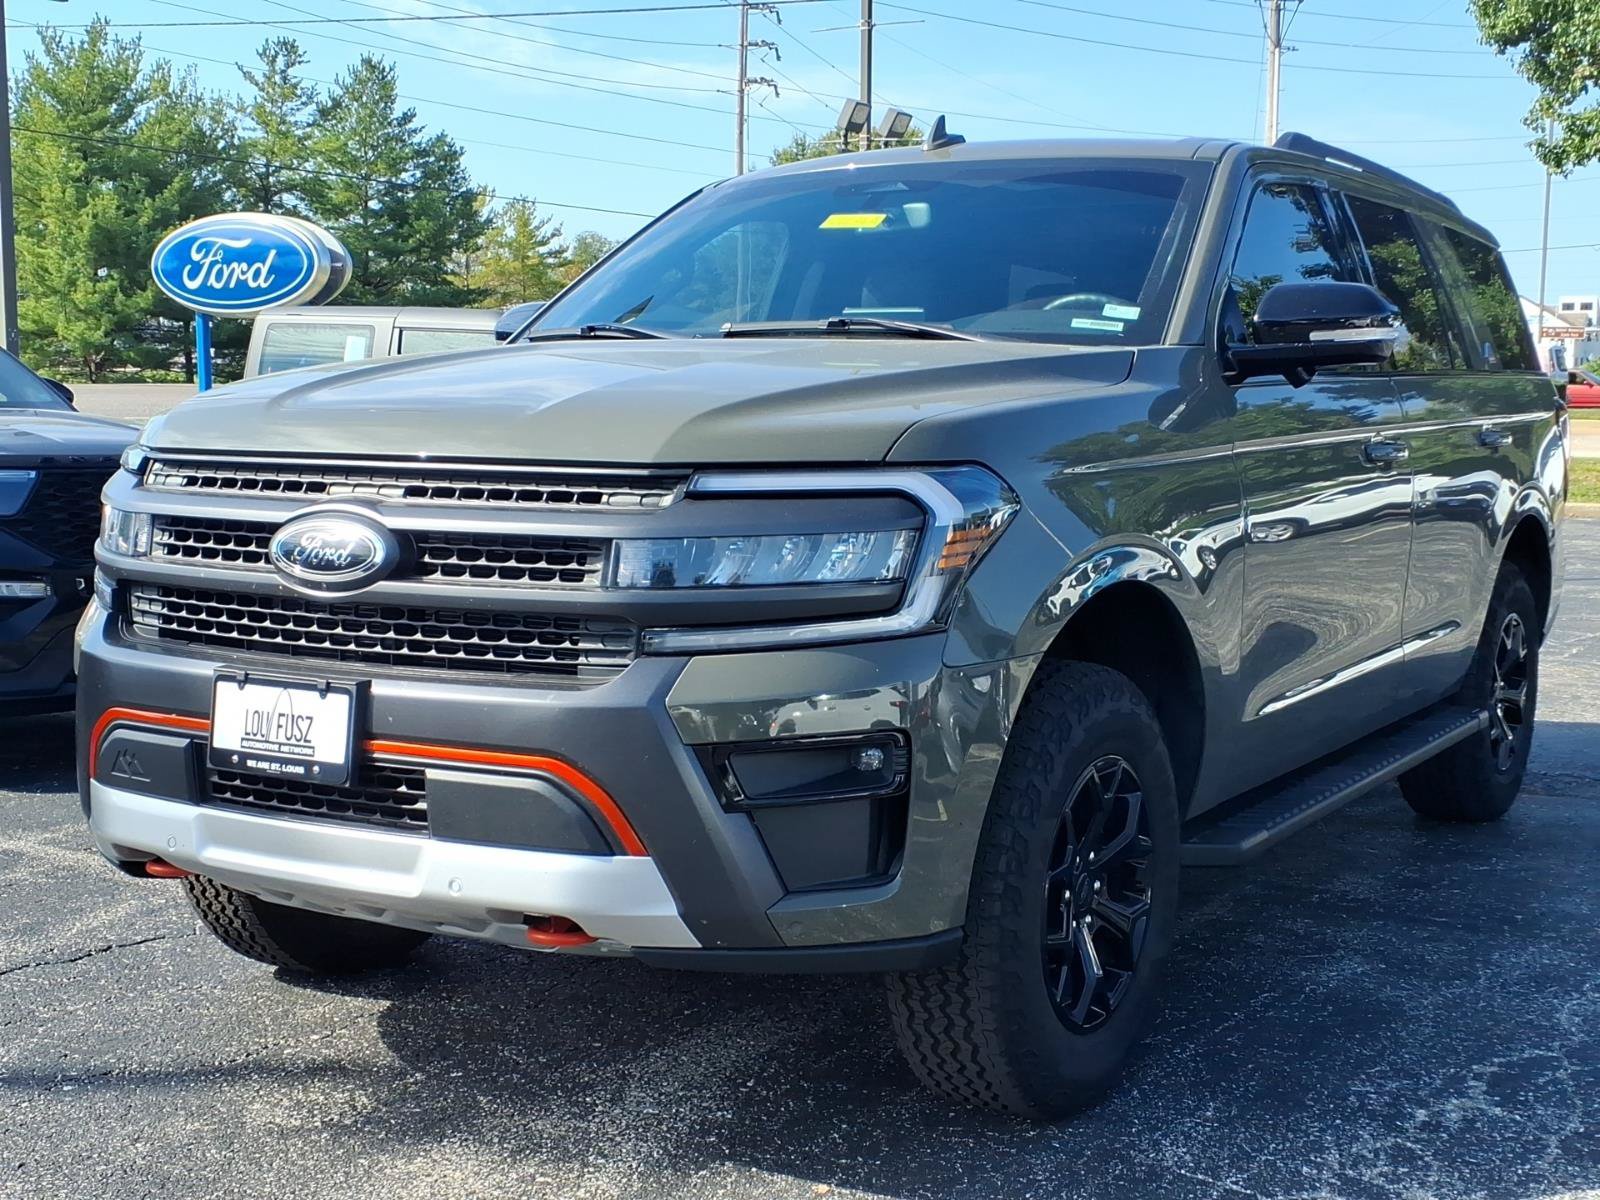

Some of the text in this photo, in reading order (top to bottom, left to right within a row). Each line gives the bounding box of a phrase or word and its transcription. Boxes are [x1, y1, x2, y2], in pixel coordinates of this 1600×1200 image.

[182, 237, 276, 290] Ford
[292, 533, 355, 566] Ford
[244, 709, 313, 744] LOU FUSZ
[241, 741, 314, 755] AUTOMOTIVE NETWORK
[246, 759, 257, 768] WE
[257, 761, 270, 769] ARE
[270, 762, 281, 771] ST.
[282, 764, 305, 774] LOUIS
